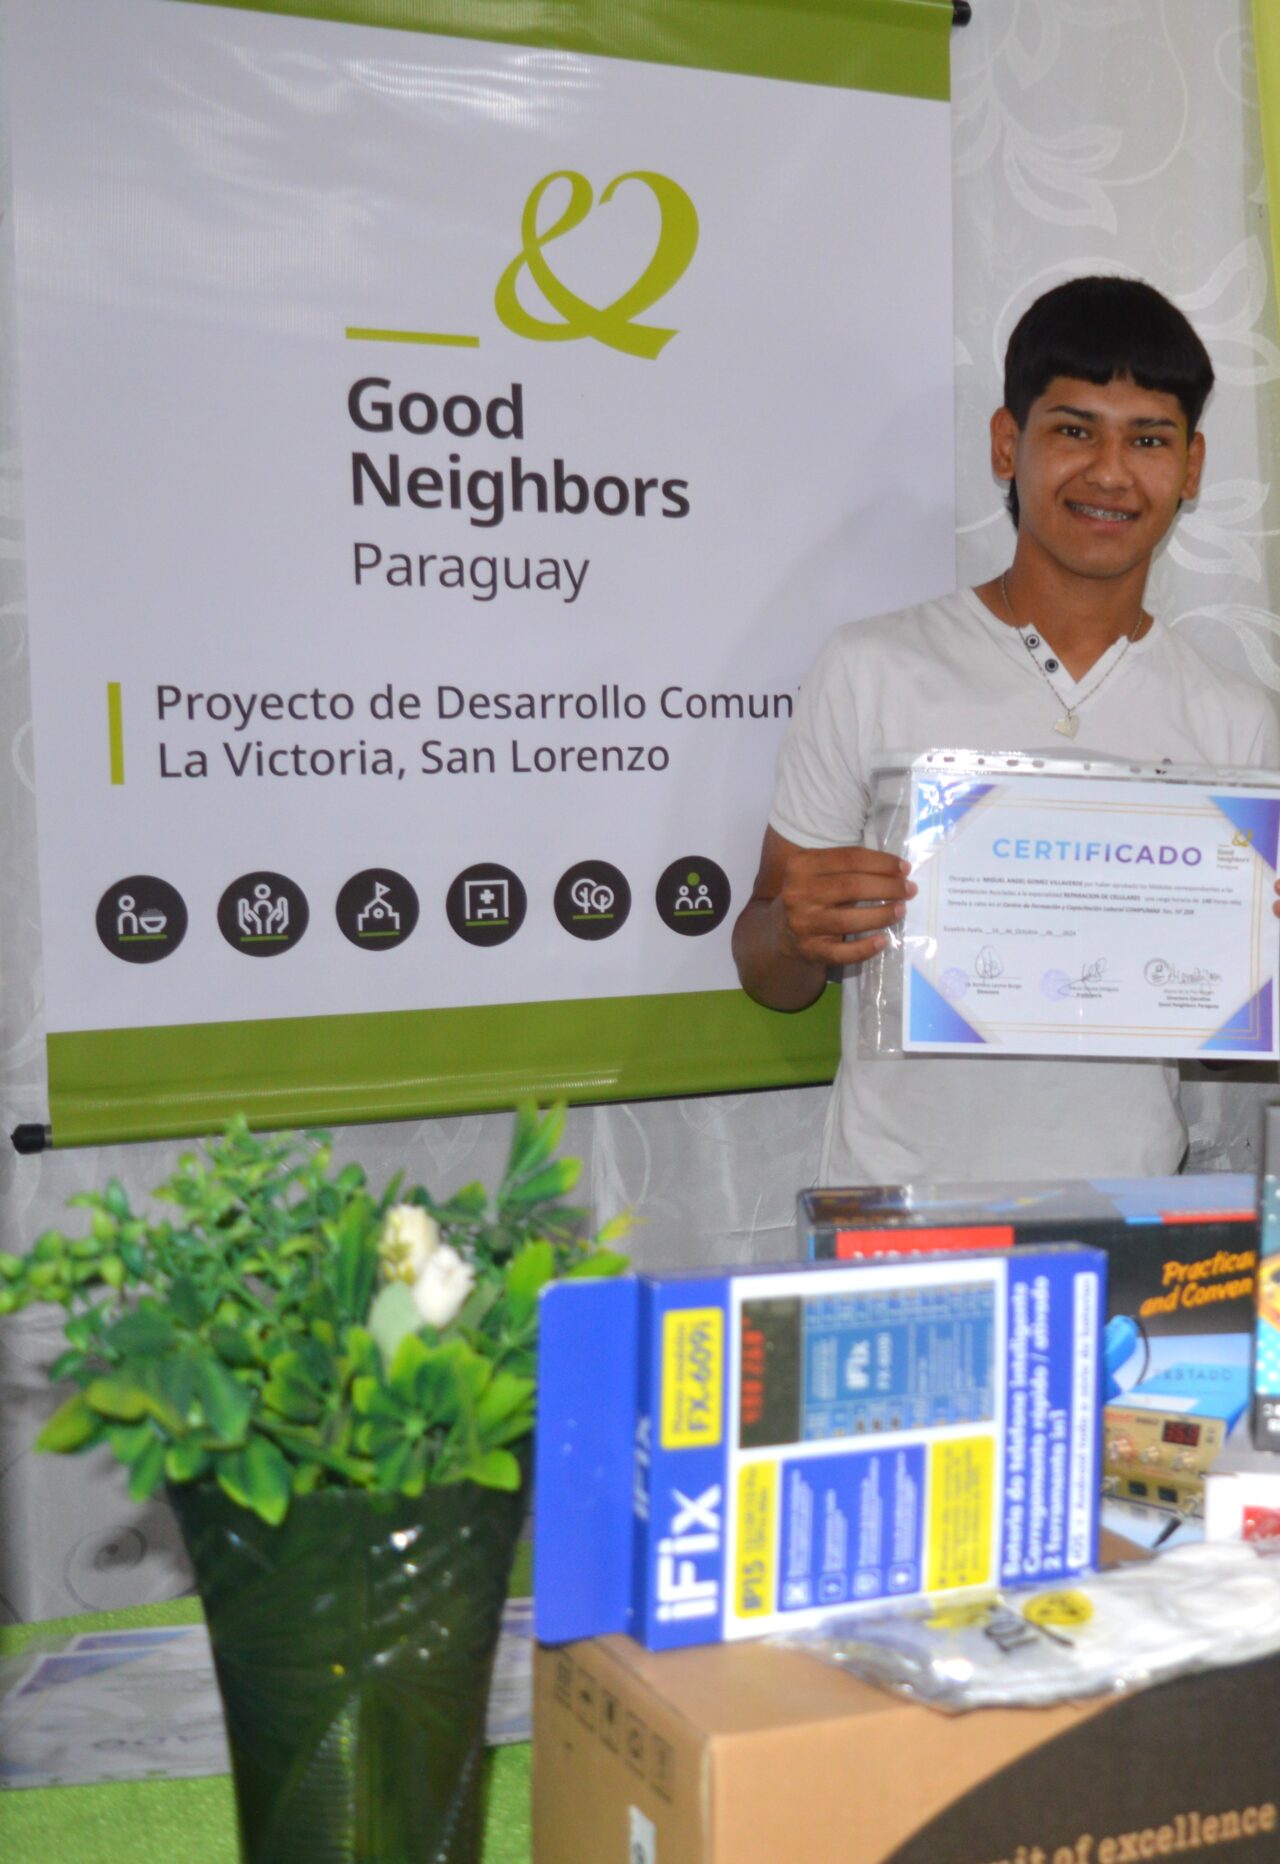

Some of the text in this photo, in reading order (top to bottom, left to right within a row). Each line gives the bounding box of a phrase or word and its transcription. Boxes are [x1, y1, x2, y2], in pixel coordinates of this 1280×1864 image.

[346, 376, 525, 440] Good
[350, 451, 691, 528] Neighbors
[352, 542, 590, 603] Paraguay
[156, 683, 801, 732] Proyecto de Desarrollo Comun
[158, 740, 670, 782] La Victoria, San Lorenzo
[991, 837, 1203, 867] CERTIFICADO
[1138, 1277, 1255, 1317] and Conven
[656, 1484, 721, 1622] iFix
[1053, 1833, 1094, 1864] of
[1098, 1802, 1278, 1864] excellence
